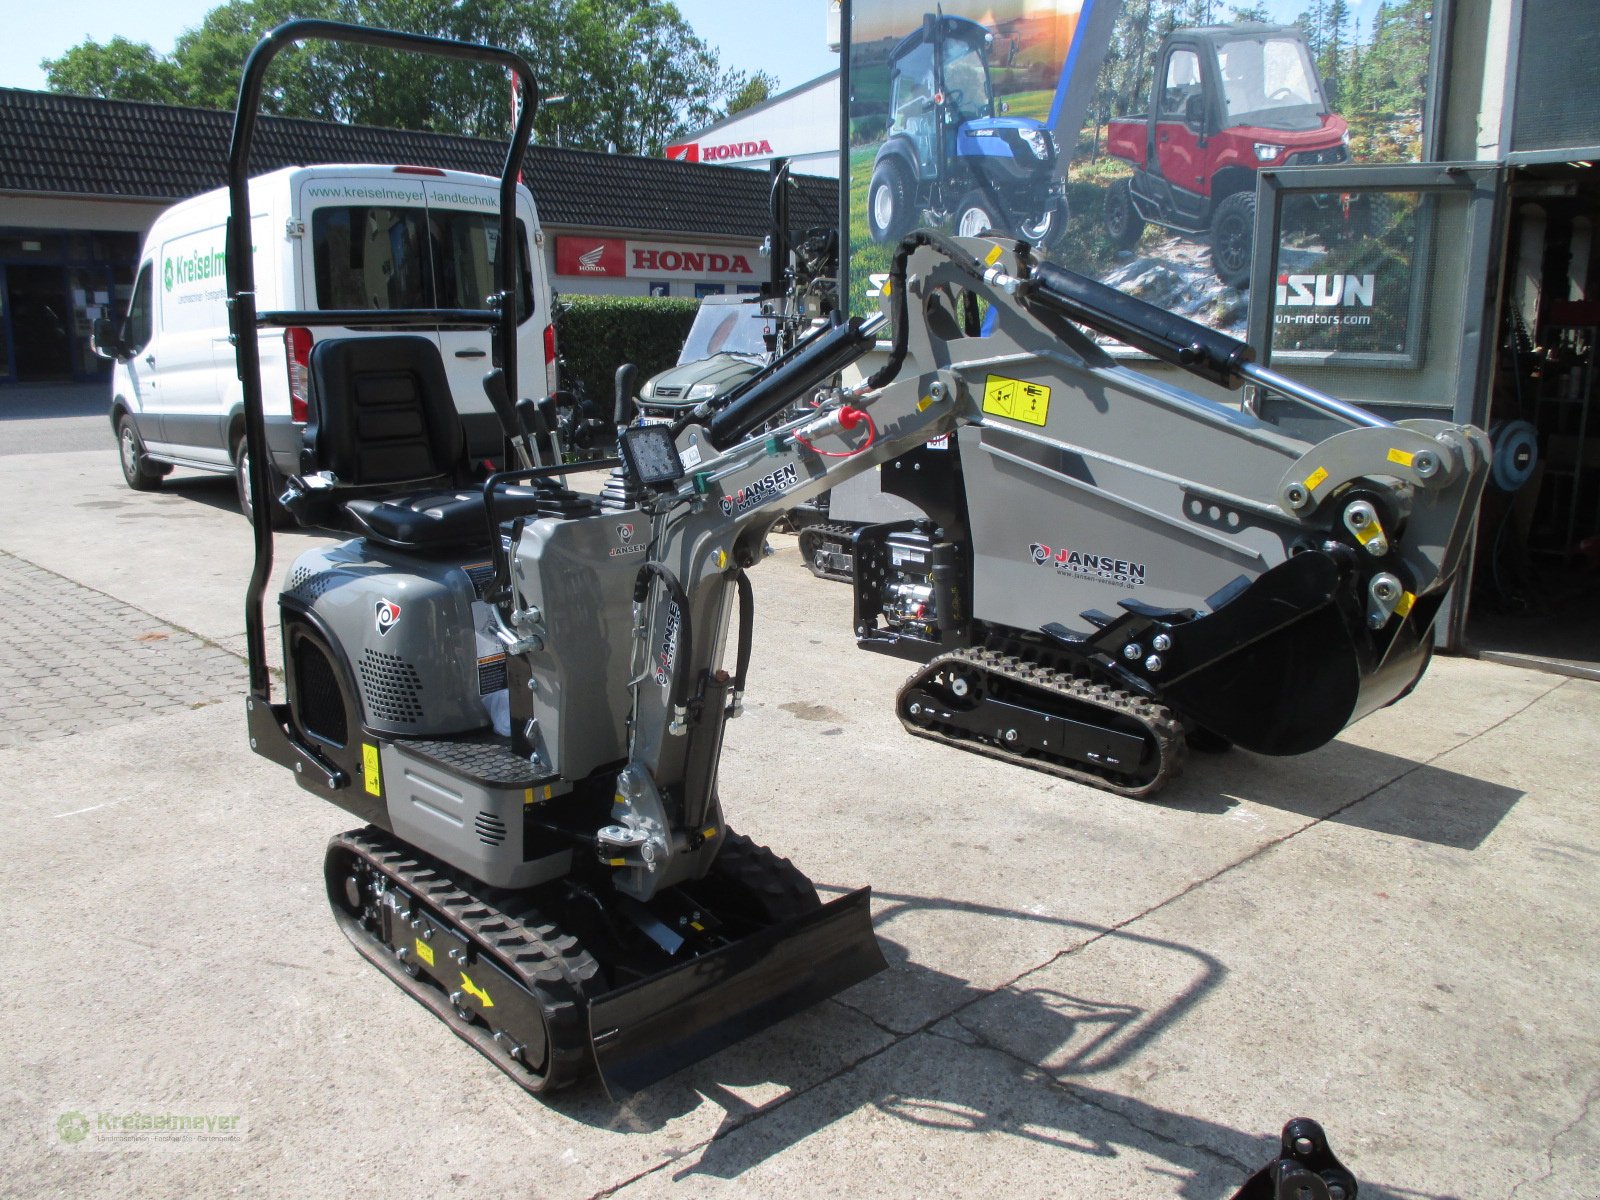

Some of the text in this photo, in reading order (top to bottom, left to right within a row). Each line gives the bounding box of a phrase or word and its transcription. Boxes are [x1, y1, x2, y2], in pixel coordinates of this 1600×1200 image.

[702, 140, 773, 161] HONDA
[578, 264, 606, 272] HONDA
[632, 249, 752, 274] HONDA
[736, 462, 796, 504] JANSEN
[609, 544, 647, 556] JANSEN
[1055, 549, 1146, 578] JANSEN
[661, 600, 679, 667] JANSE
